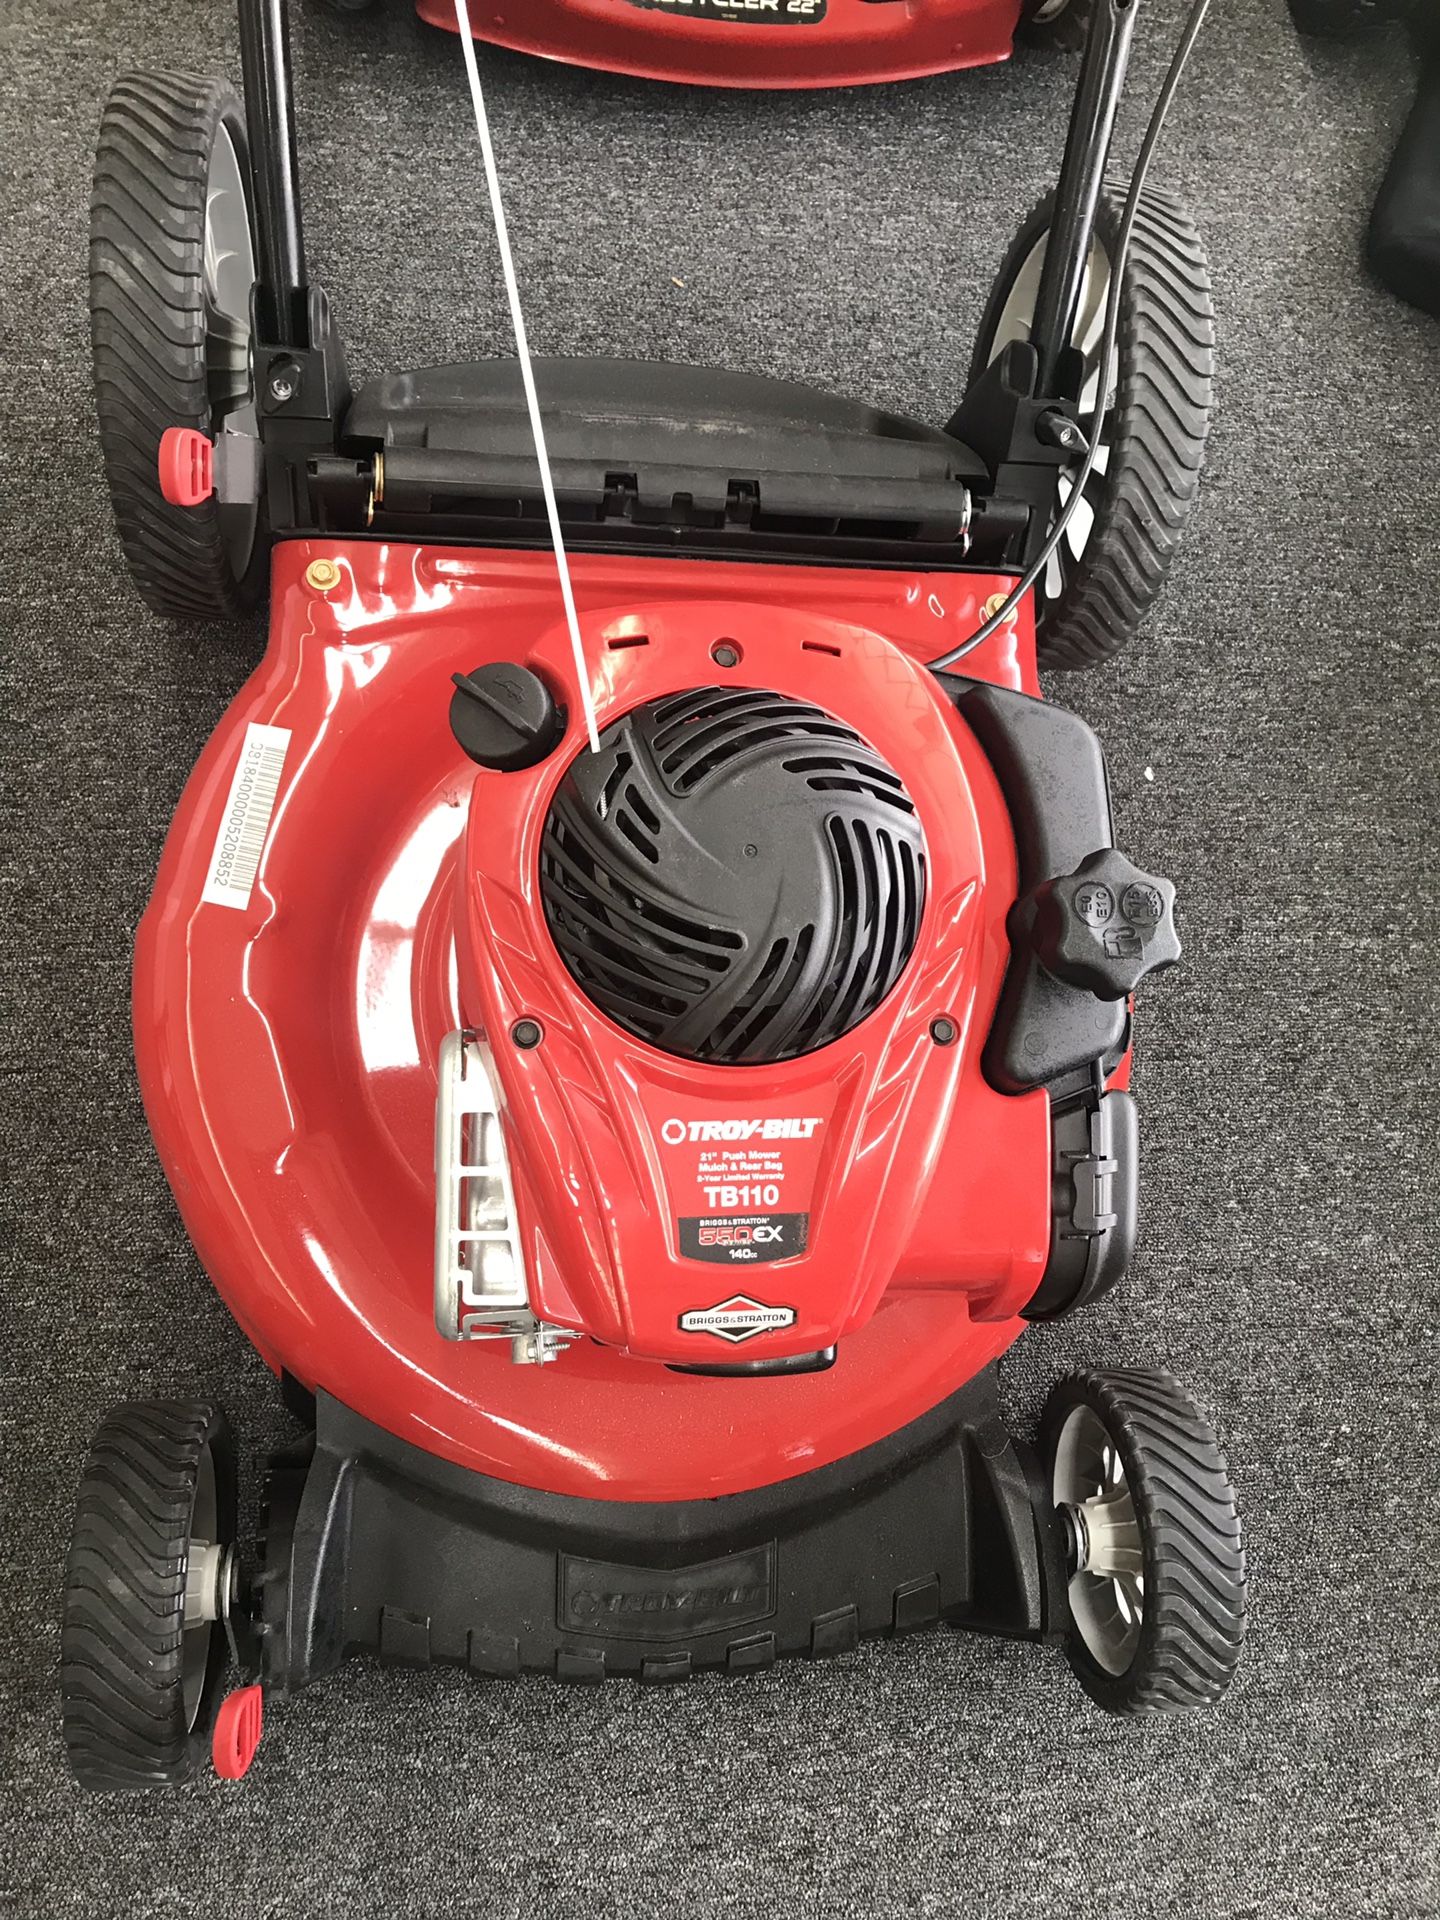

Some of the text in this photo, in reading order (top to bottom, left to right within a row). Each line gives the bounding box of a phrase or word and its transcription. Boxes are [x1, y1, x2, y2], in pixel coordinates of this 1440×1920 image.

[687, 1117, 819, 1142] TROY-BILT
[700, 1150, 781, 1161] 21" Push Mower
[698, 1160, 783, 1172] Mulch & Rear Bag
[723, 1173, 750, 1181] Limited
[751, 1172, 785, 1181] Warranty
[703, 1184, 779, 1208] TB110
[729, 1248, 758, 1259] 140cc
[689, 1313, 787, 1325] BRIGGS&STRATTON
